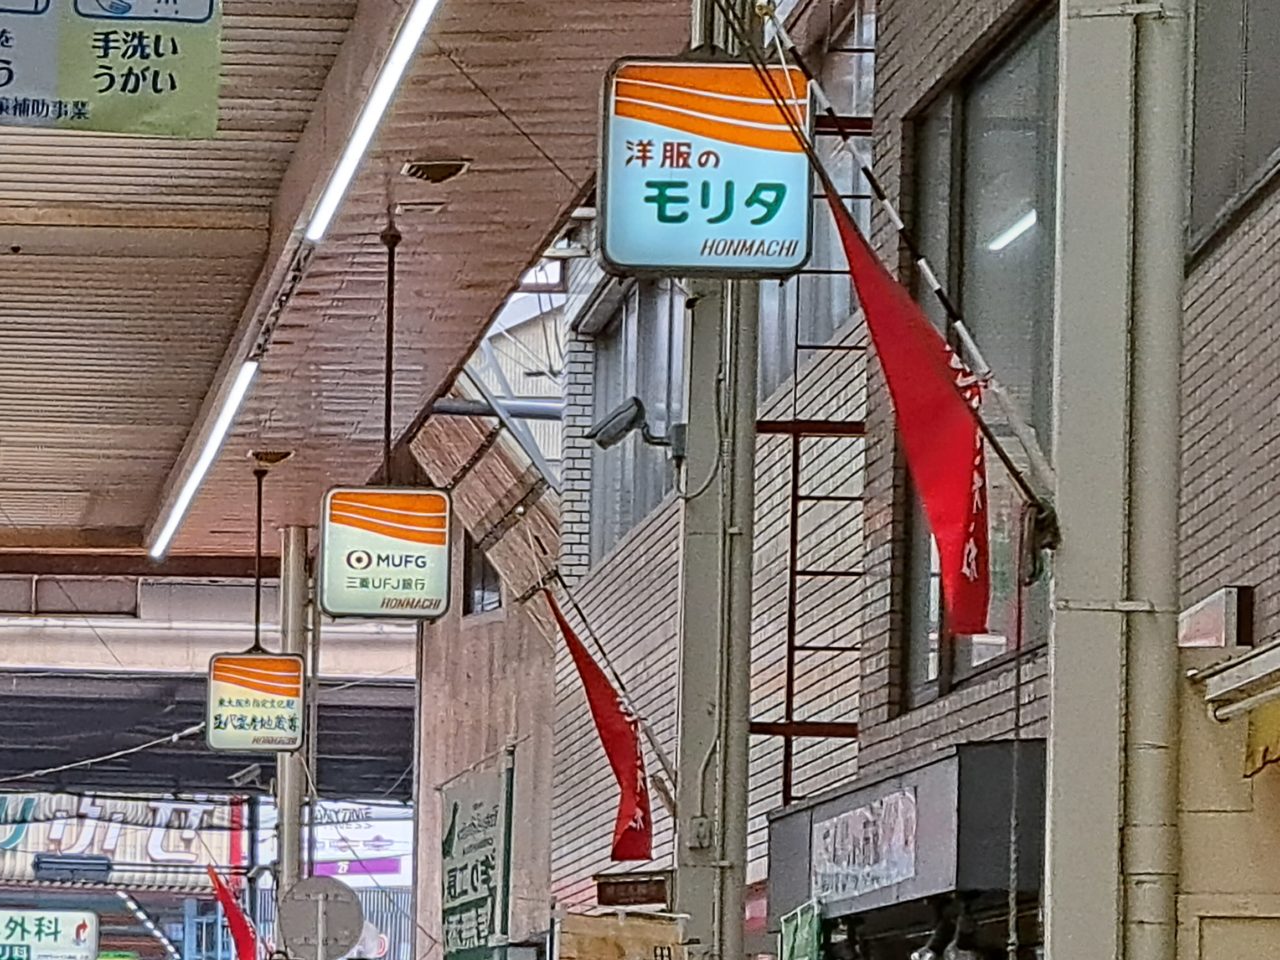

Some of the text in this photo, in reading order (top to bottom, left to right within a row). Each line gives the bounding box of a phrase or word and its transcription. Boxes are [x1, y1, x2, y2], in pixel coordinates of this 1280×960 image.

[91, 30, 179, 59] 手洗い
[92, 65, 178, 95] うがい
[625, 139, 721, 169] 洋服の
[643, 179, 788, 226] モリタ
[699, 238, 800, 258] HONMACHI
[376, 554, 428, 570] MUFG
[345, 576, 427, 592] 三菱UFJ銀行
[379, 597, 442, 611] HONMACHI
